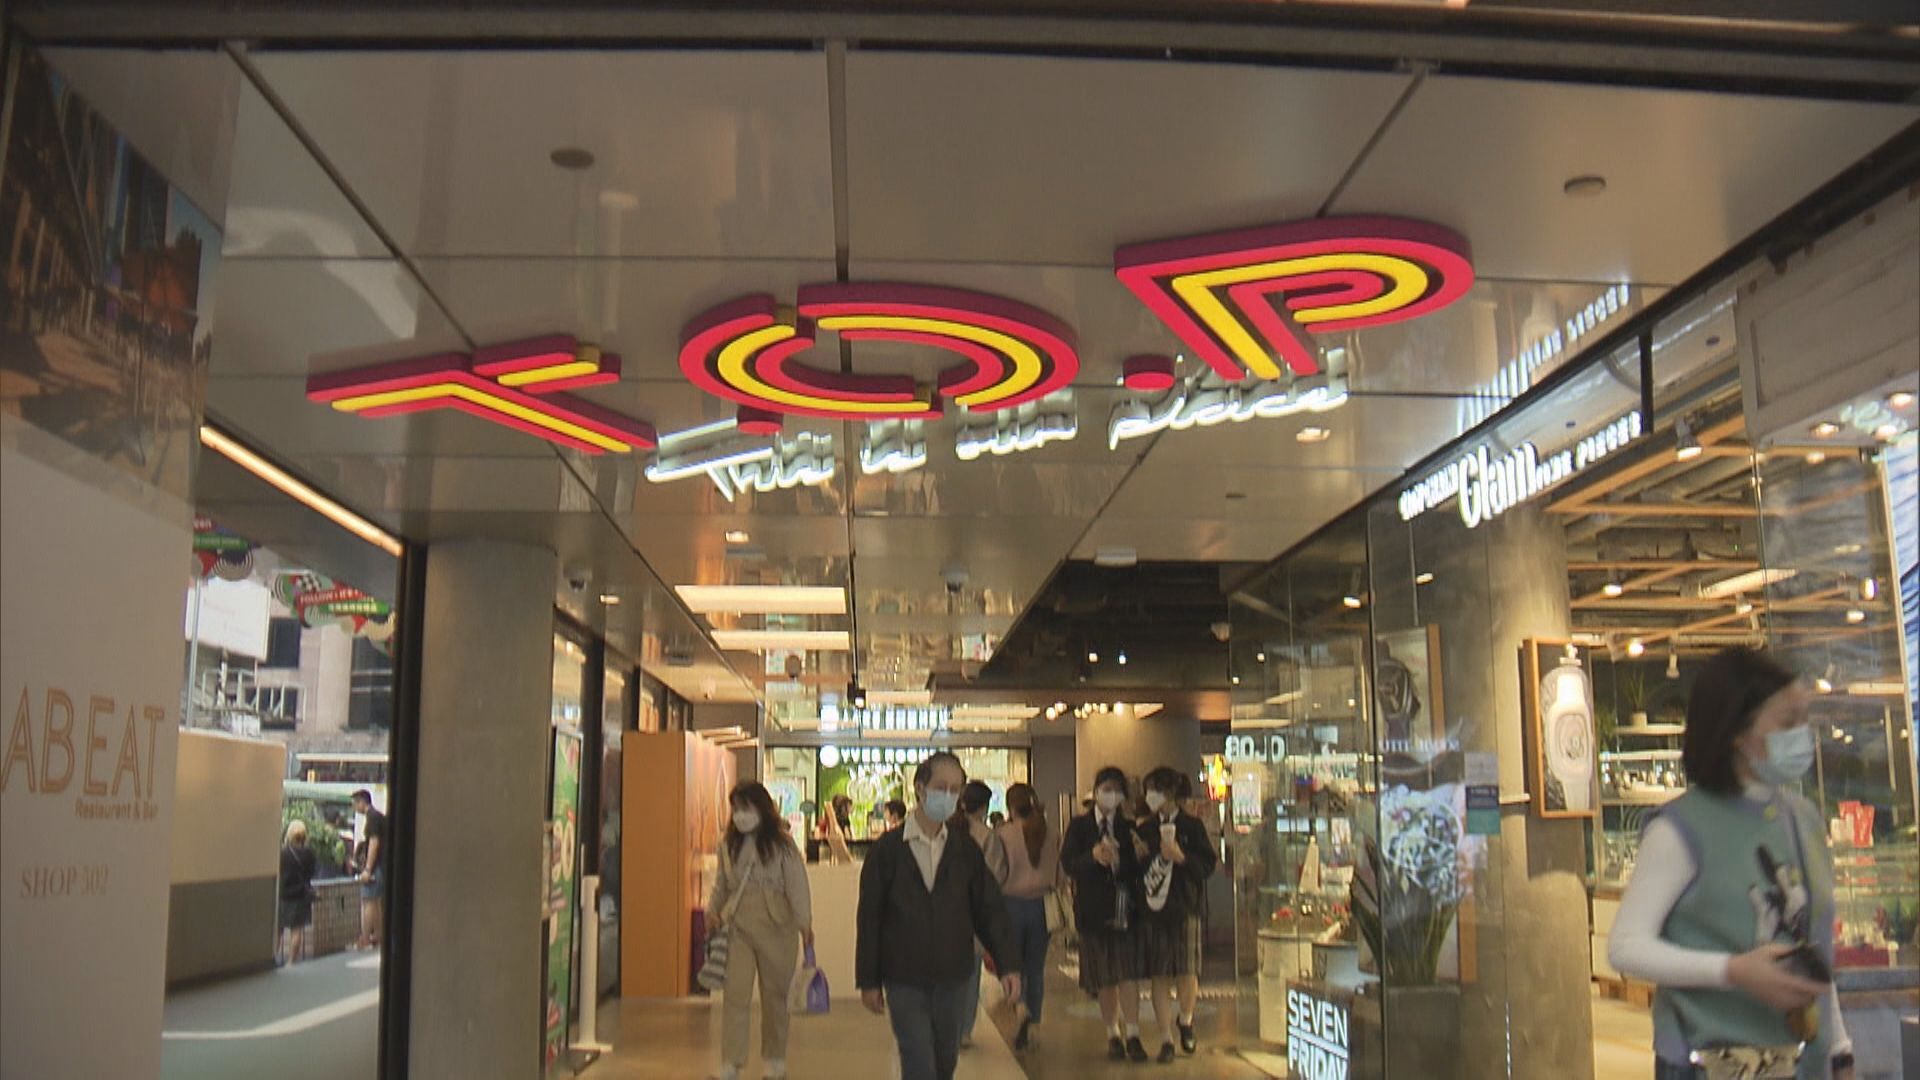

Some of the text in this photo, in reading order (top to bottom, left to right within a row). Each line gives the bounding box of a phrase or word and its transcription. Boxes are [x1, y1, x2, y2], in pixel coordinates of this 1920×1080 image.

[75, 798, 132, 820] Restaurant
[143, 803, 159, 822] Bar
[20, 866, 77, 898] SHOP
[1287, 989, 1348, 1048] SEVEN
